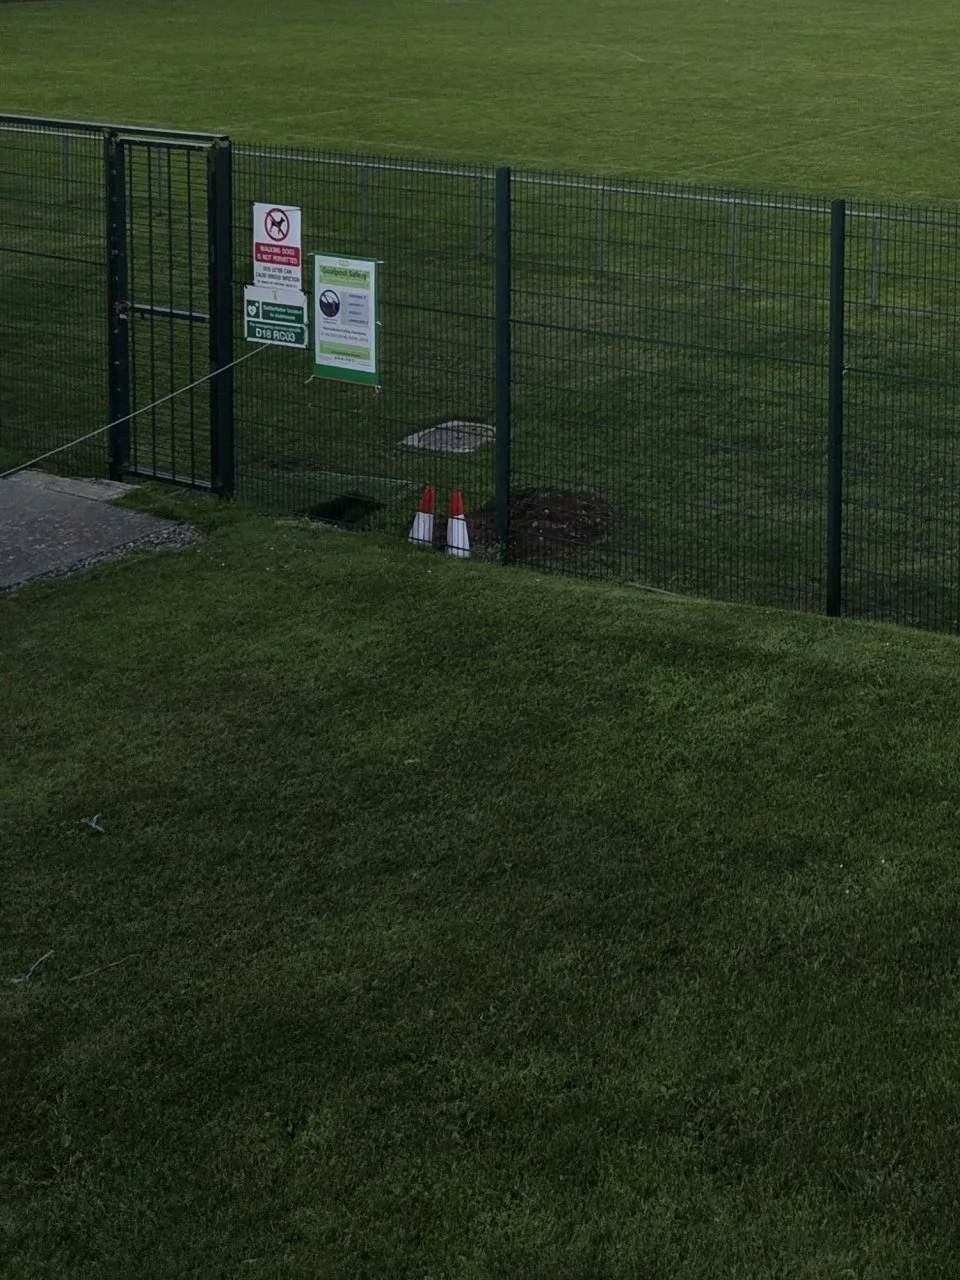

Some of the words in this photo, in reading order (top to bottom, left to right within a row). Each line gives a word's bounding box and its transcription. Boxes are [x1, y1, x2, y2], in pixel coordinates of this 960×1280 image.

[260, 246, 280, 254] WALKING
[282, 248, 295, 256] DOGS
[273, 256, 298, 265] PERMITTED
[284, 267, 292, 275] CAN
[321, 266, 347, 277] Goalpost
[349, 269, 367, 281] Safety
[255, 327, 272, 339] D18
